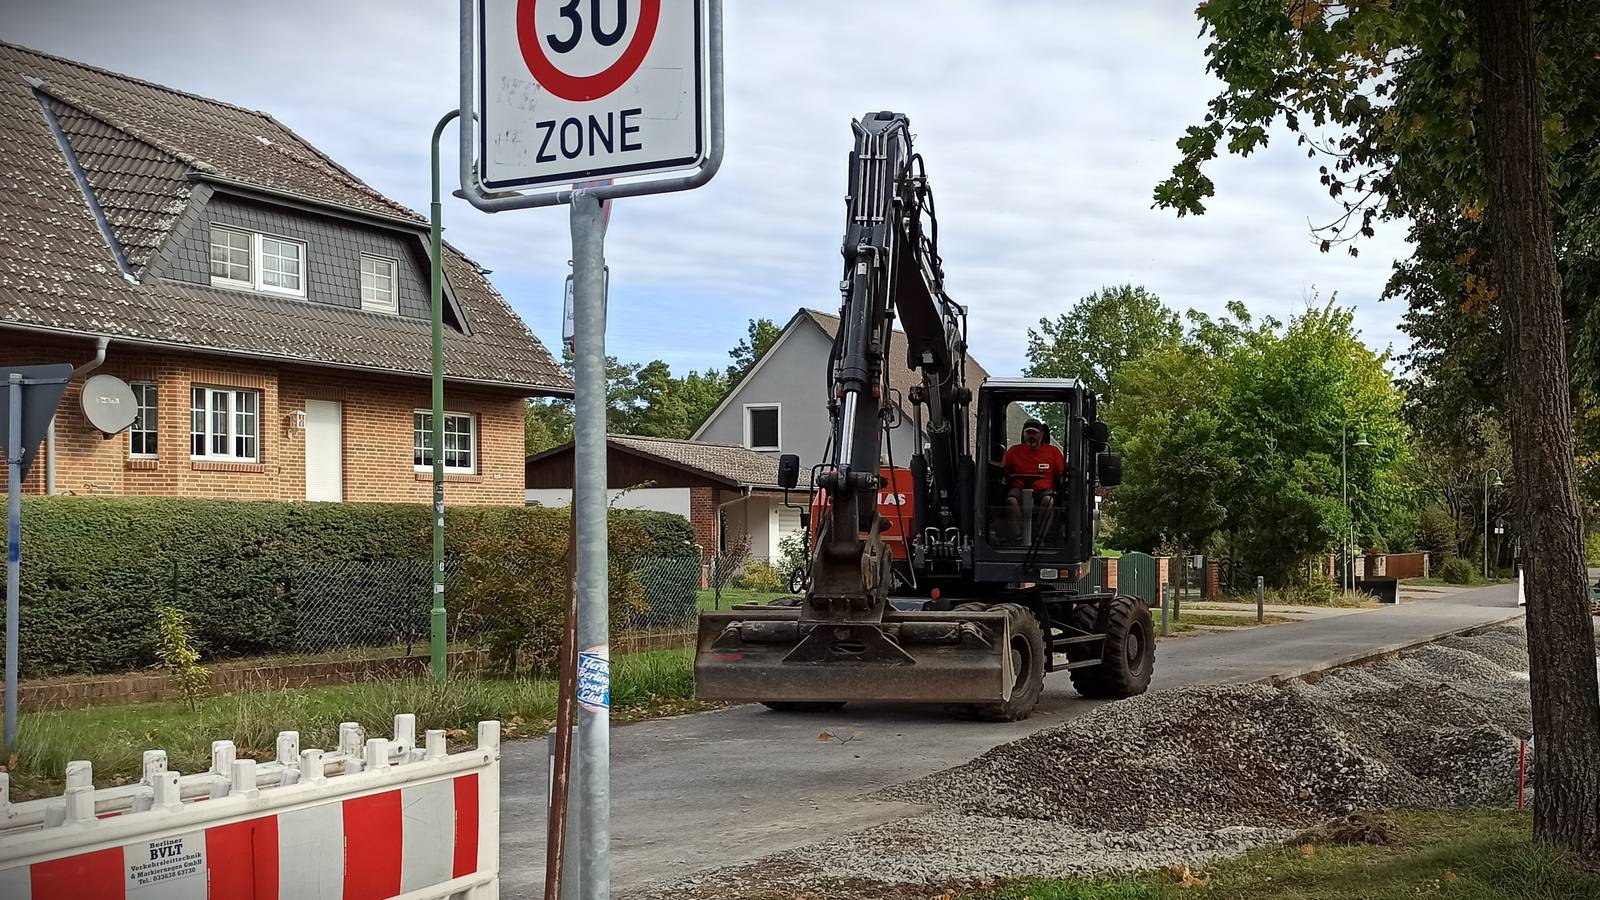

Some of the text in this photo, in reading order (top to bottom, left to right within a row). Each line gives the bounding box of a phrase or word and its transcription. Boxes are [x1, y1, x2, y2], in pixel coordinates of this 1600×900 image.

[546, 0, 627, 53] 30
[536, 108, 642, 163] ZONE
[581, 690, 605, 702] Club
[149, 838, 182, 848] Berliner
[150, 844, 183, 860] BVLT
[130, 852, 202, 871] Verkehrsleittechnik
[184, 859, 202, 868] GmbH
